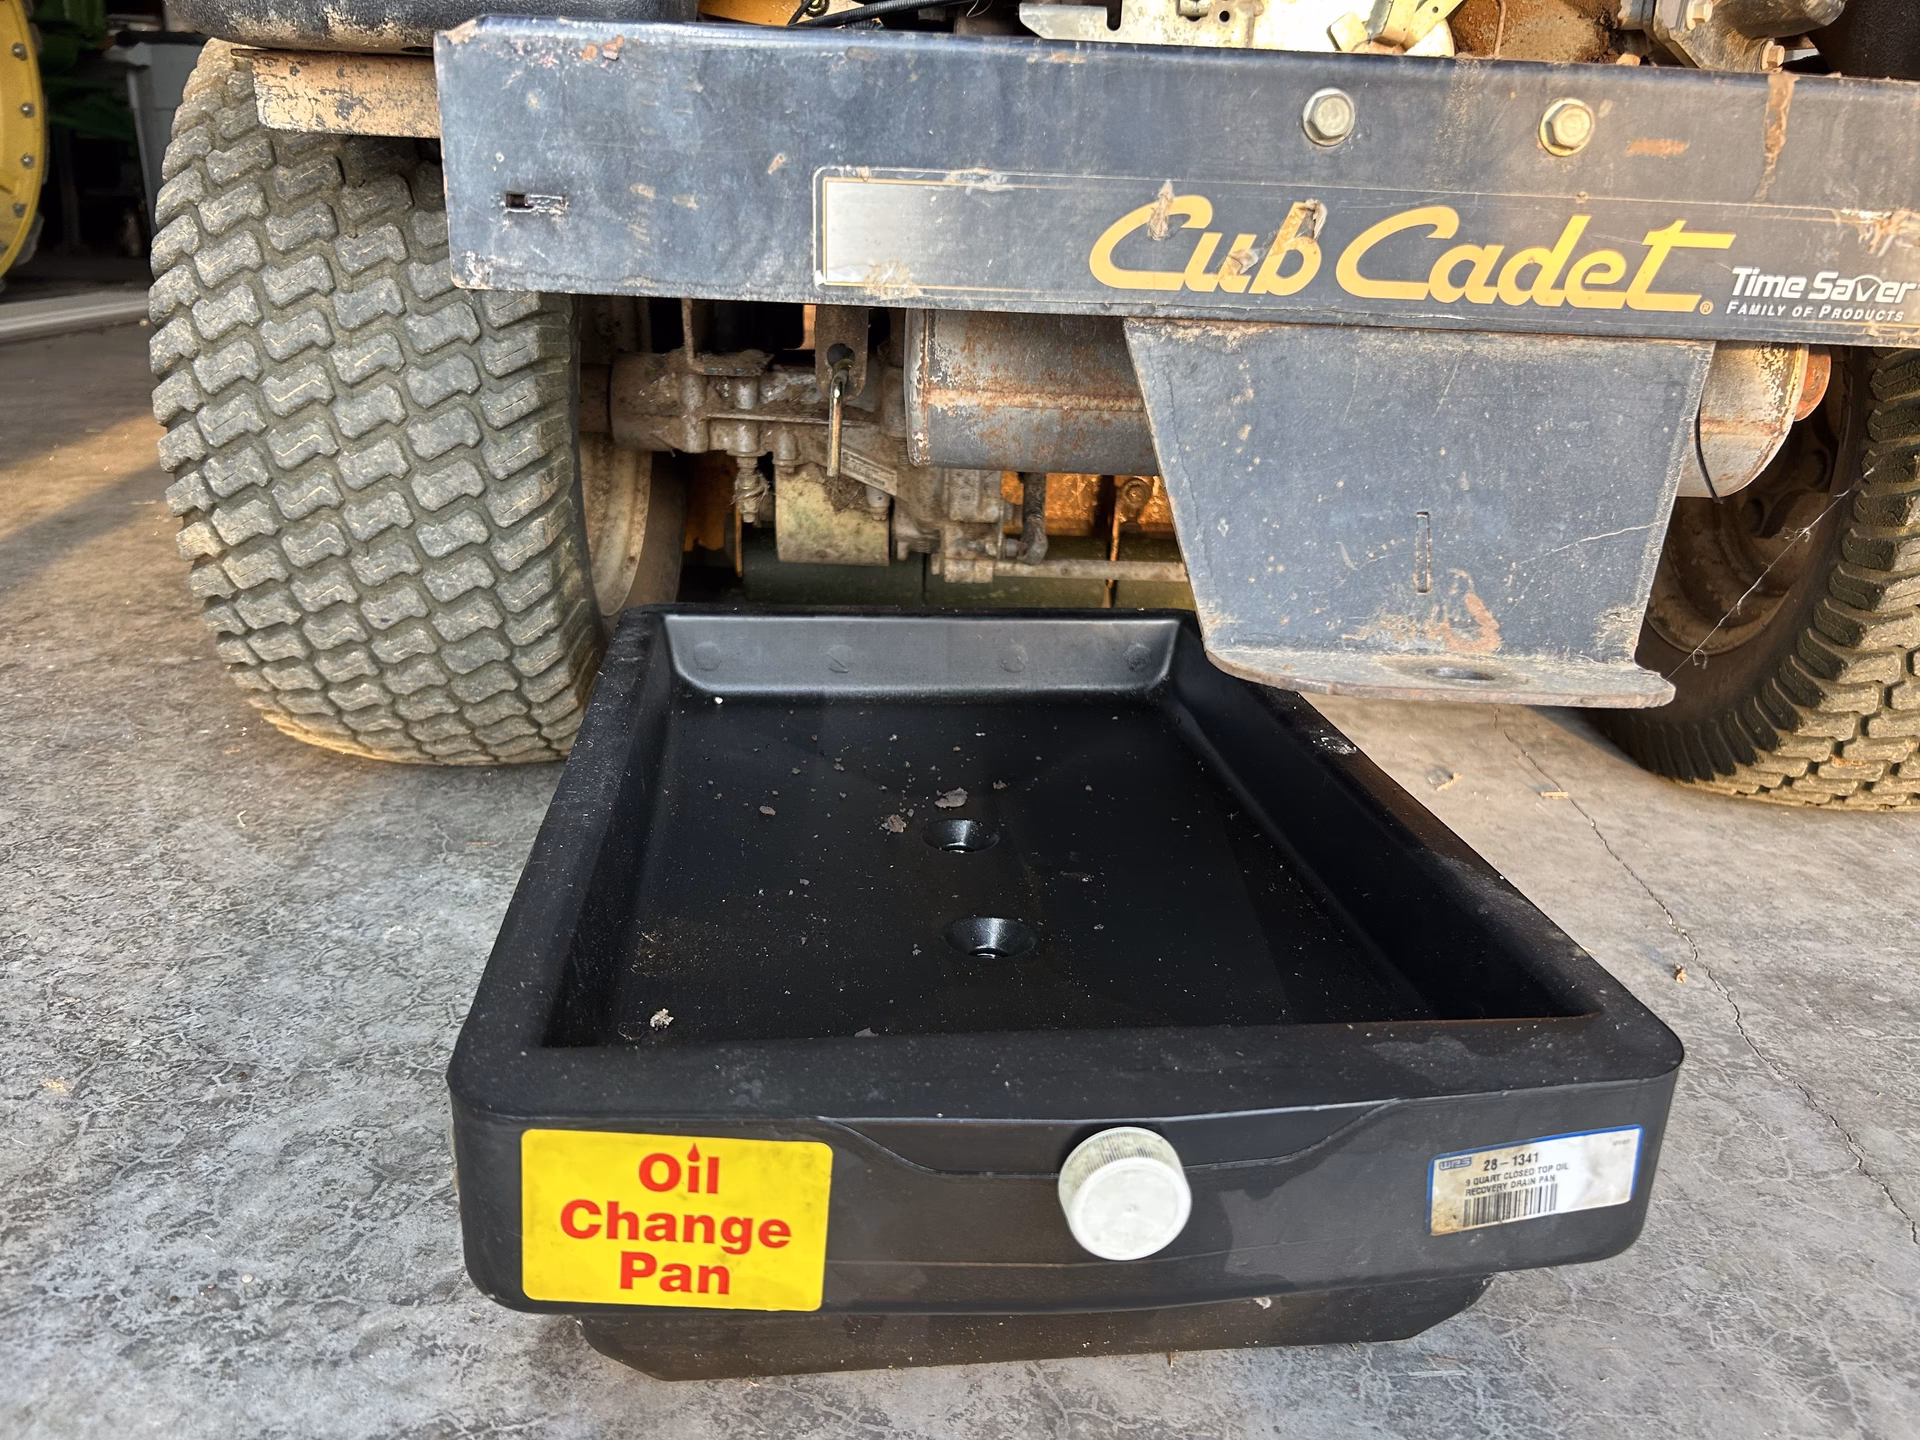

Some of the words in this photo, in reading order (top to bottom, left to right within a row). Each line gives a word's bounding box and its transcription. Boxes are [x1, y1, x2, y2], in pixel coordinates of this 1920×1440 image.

[1088, 194, 1322, 296] Cub
[1732, 266, 1807, 299] Time
[1808, 271, 1917, 304] Saver
[1725, 300, 1786, 317] FAMILY
[1791, 306, 1813, 318] OF
[1819, 304, 1904, 322] PRODUCTS
[638, 1142, 719, 1194] Oil
[1465, 1182, 1508, 1197] RECOVERY
[1510, 1177, 1536, 1189] DRAIN
[1539, 1174, 1556, 1183] PAN
[1473, 1174, 1502, 1186] QUART
[1503, 1168, 1535, 1180] CLOSED
[1538, 1164, 1554, 1174] TOP
[1555, 1162, 1569, 1171] OIL
[560, 1198, 791, 1255] Change
[620, 1250, 730, 1295] Pan
